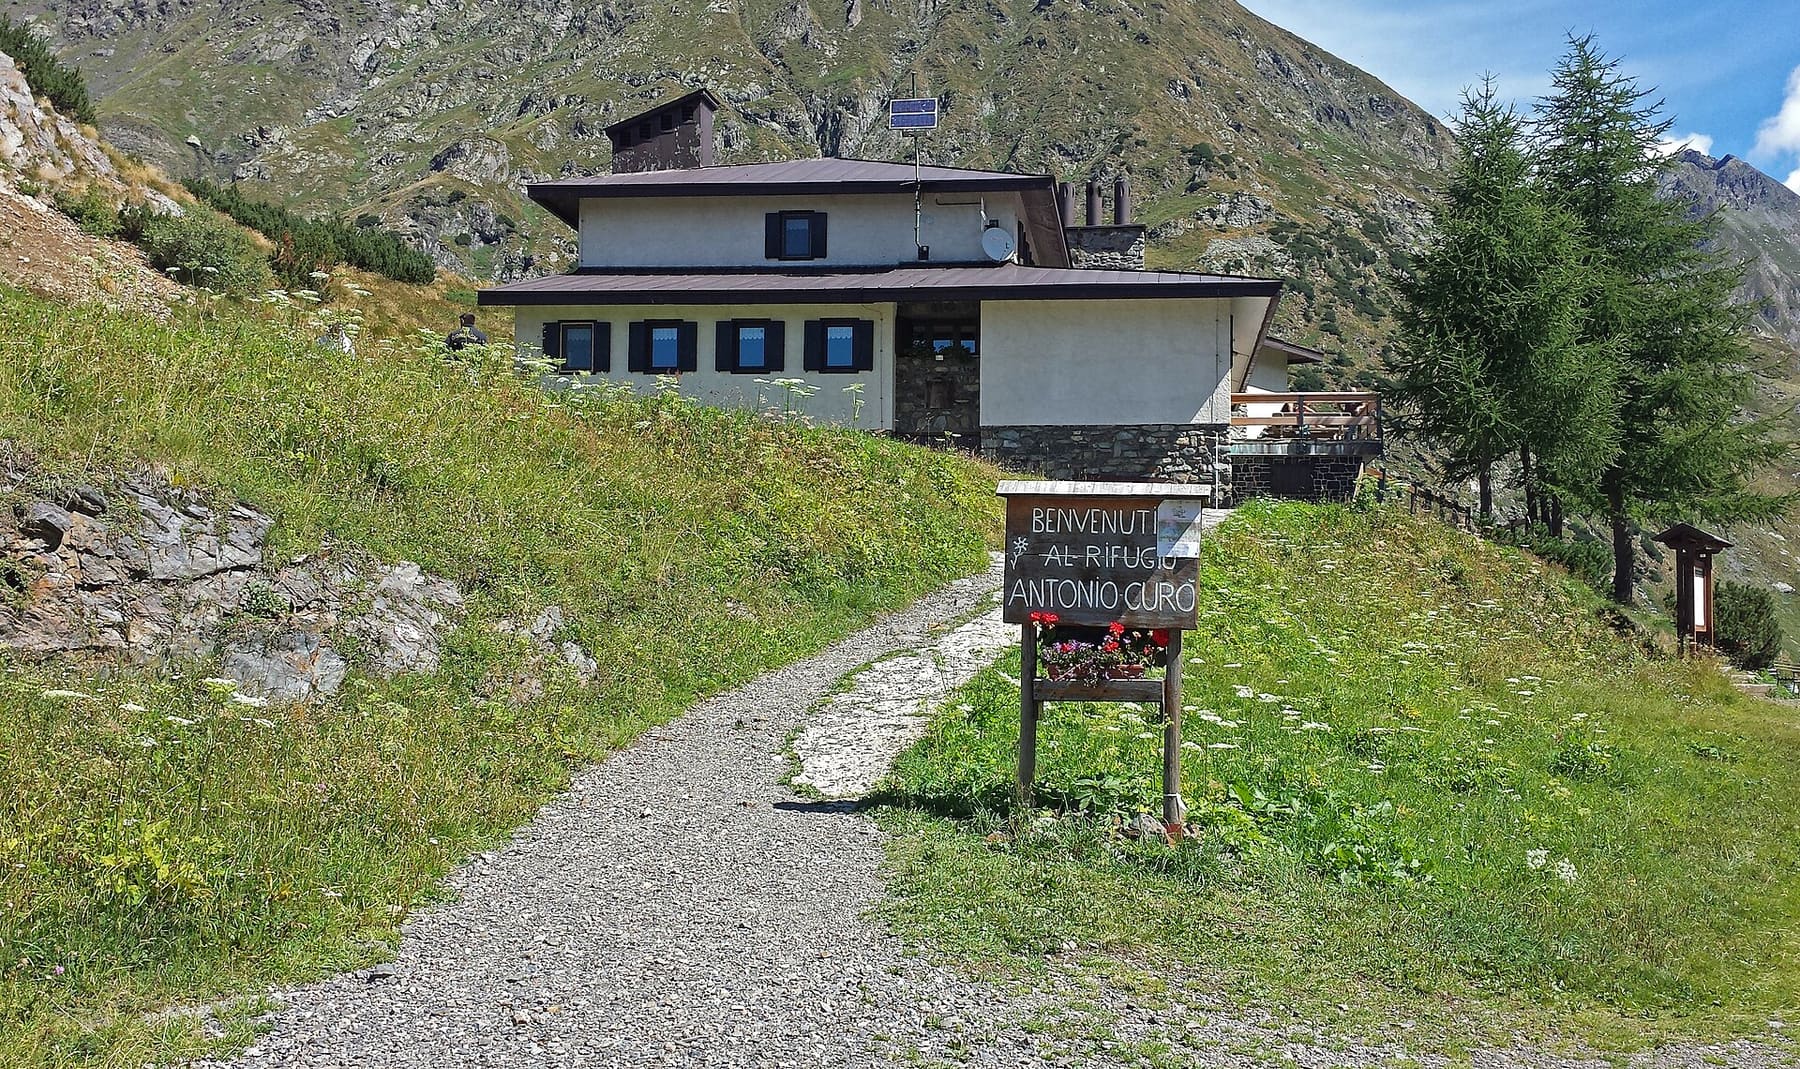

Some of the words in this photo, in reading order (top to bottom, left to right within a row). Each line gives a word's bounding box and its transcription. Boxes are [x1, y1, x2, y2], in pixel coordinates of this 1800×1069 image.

[1032, 506, 1157, 535] BENVENUTI
[1044, 544, 1074, 567] AL
[1008, 576, 1118, 609] ANTONIO
